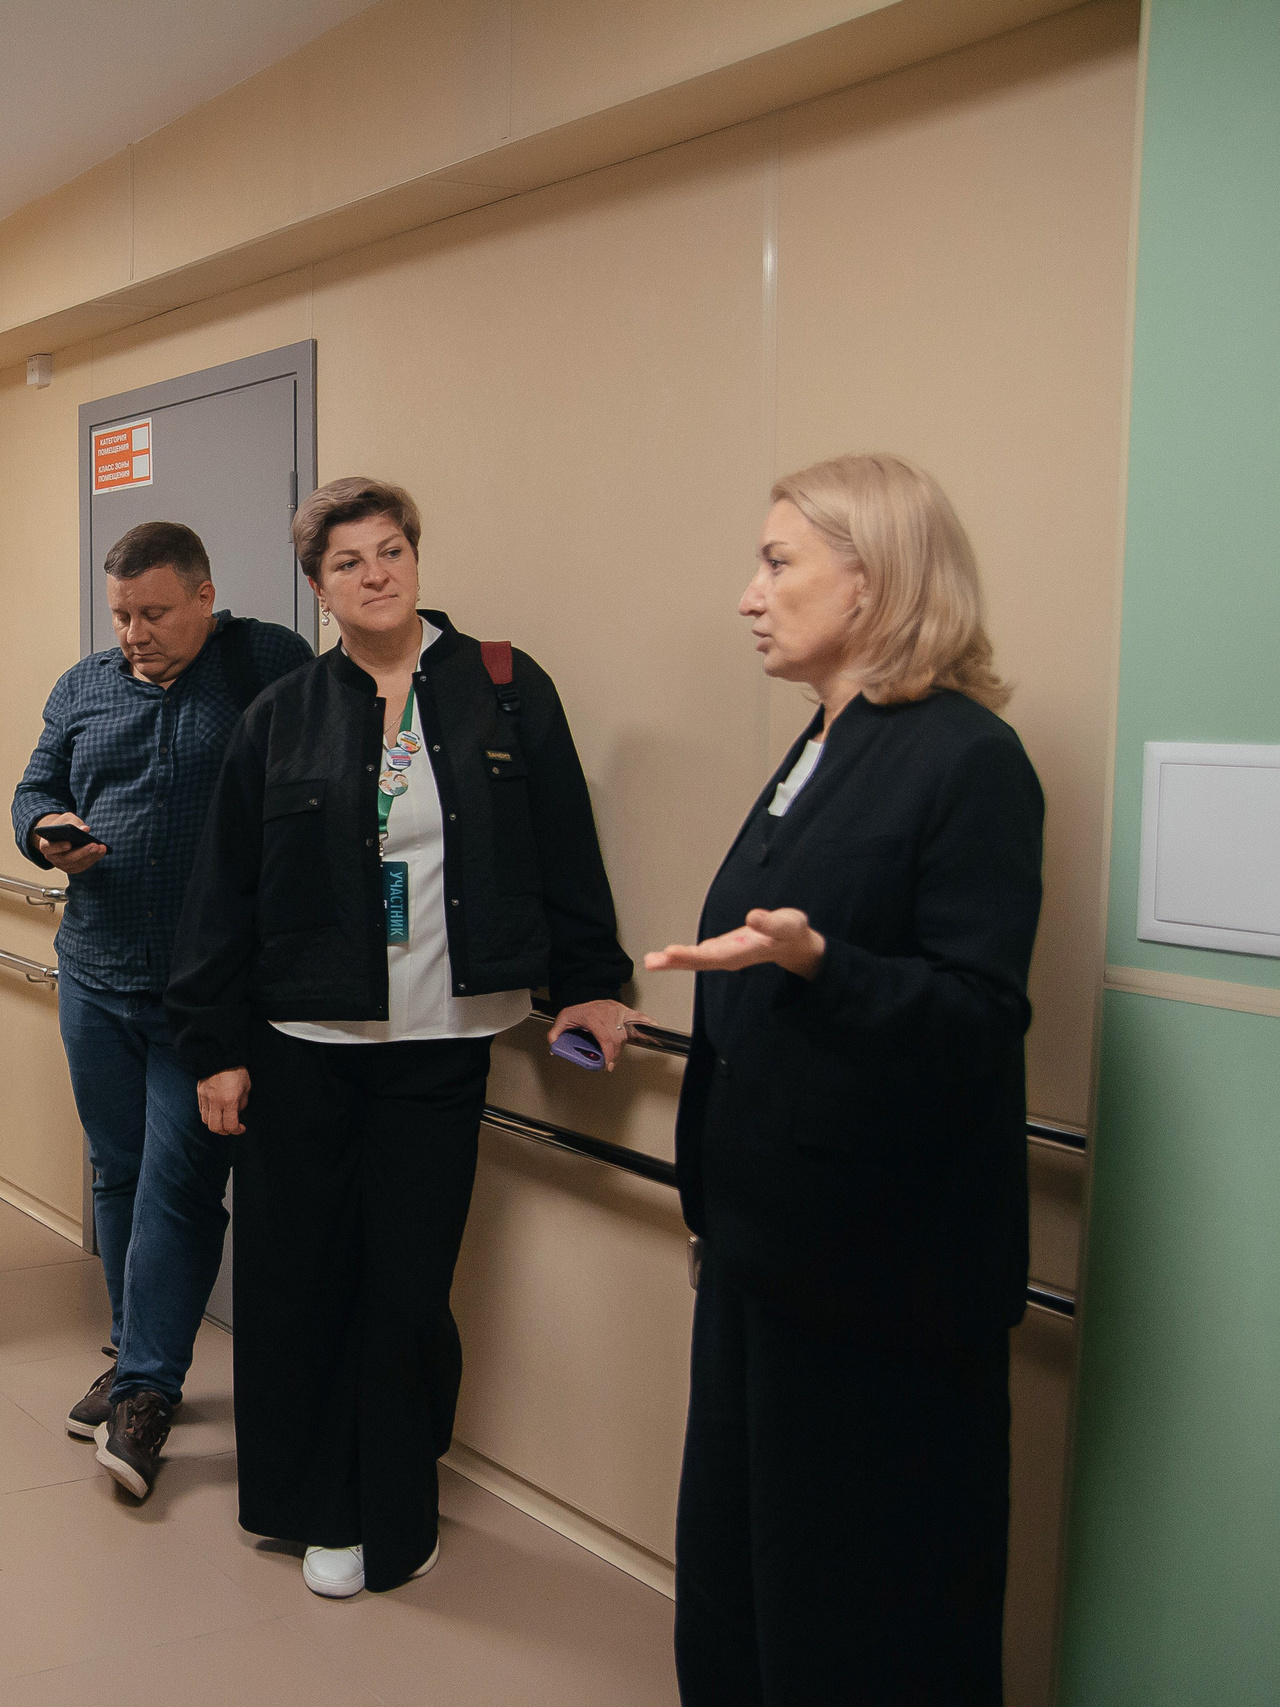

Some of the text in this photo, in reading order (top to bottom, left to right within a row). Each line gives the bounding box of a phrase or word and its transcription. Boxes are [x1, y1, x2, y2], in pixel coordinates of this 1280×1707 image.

[100, 433, 127, 446] КАТЕГОРИЯ
[98, 443, 129, 456] ПОМЕЩЕНИЯ
[98, 460, 129, 473] КЛАСС ЗОНЫ
[98, 469, 129, 482] ПОМЕЩЕНИЯ
[390, 872, 403, 936] УЧАСТНИК
